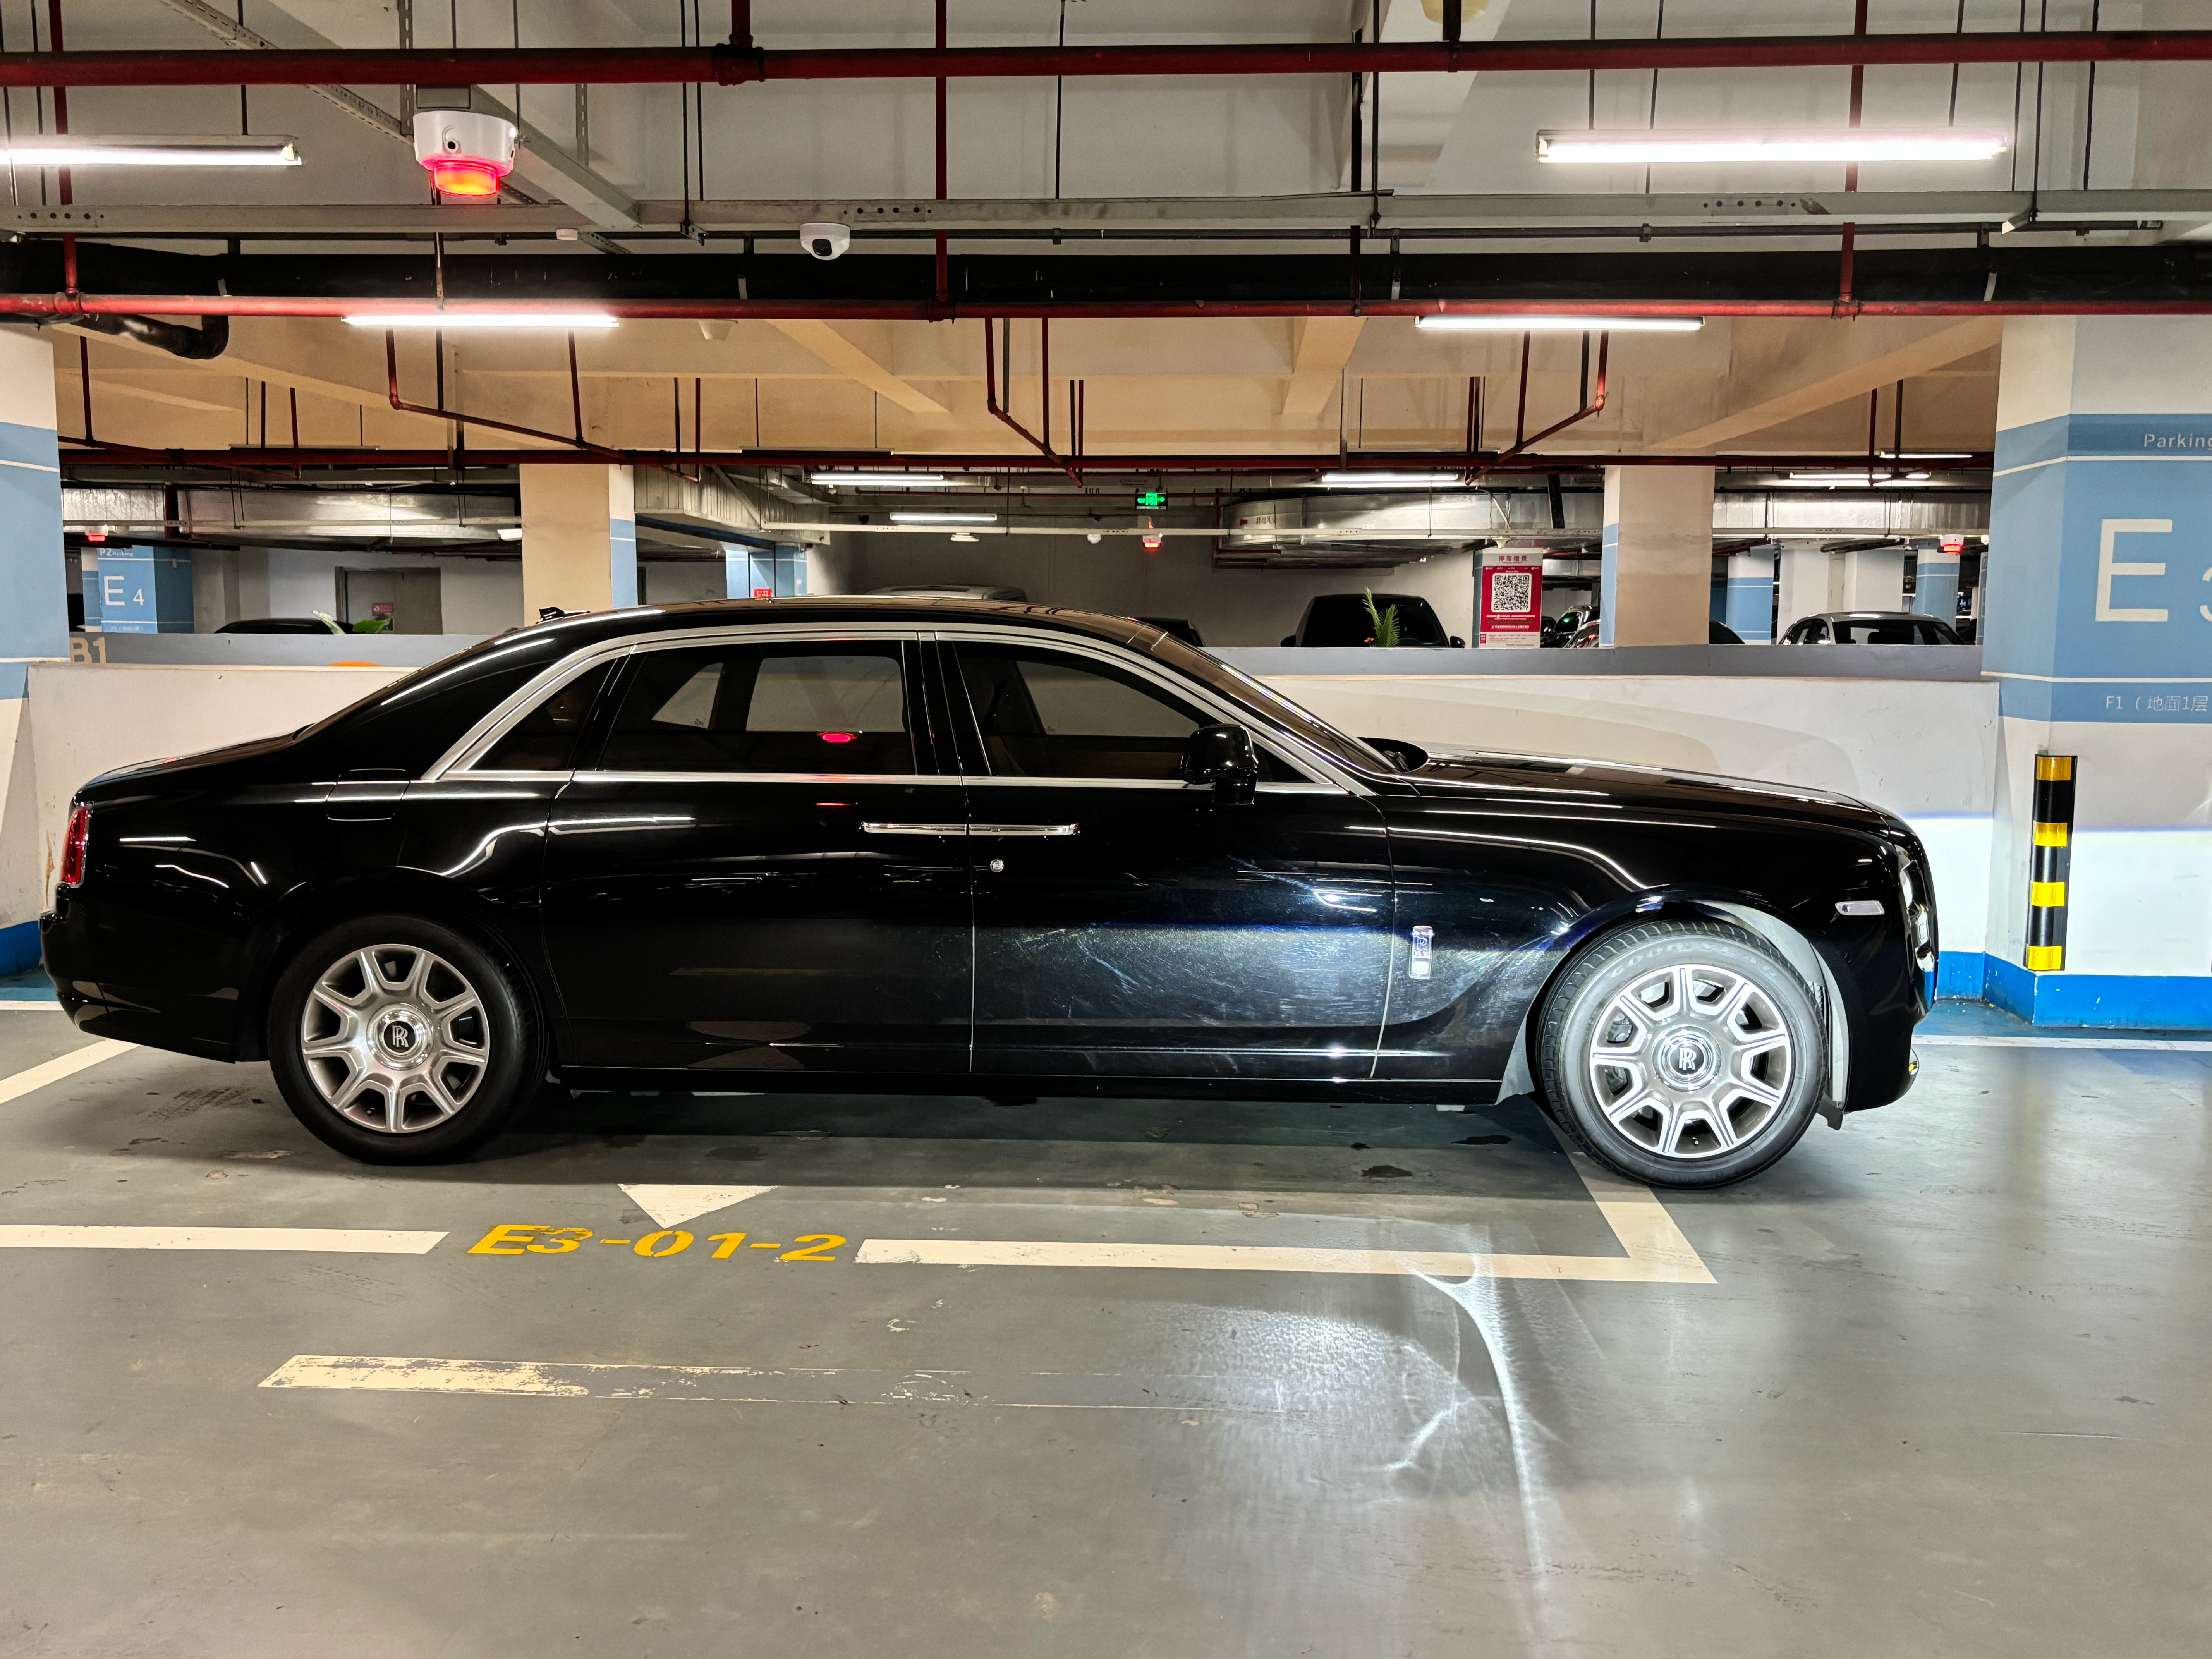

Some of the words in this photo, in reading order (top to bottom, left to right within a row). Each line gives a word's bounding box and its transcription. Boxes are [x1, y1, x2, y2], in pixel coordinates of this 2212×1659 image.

[104, 576, 125, 606] E
[133, 588, 144, 606] 4
[70, 637, 107, 664] B1
[2106, 696, 2123, 709] F1
[392, 1025, 409, 1048] RR
[1679, 1048, 1697, 1070] RR
[467, 1224, 847, 1261] E3-01-2
